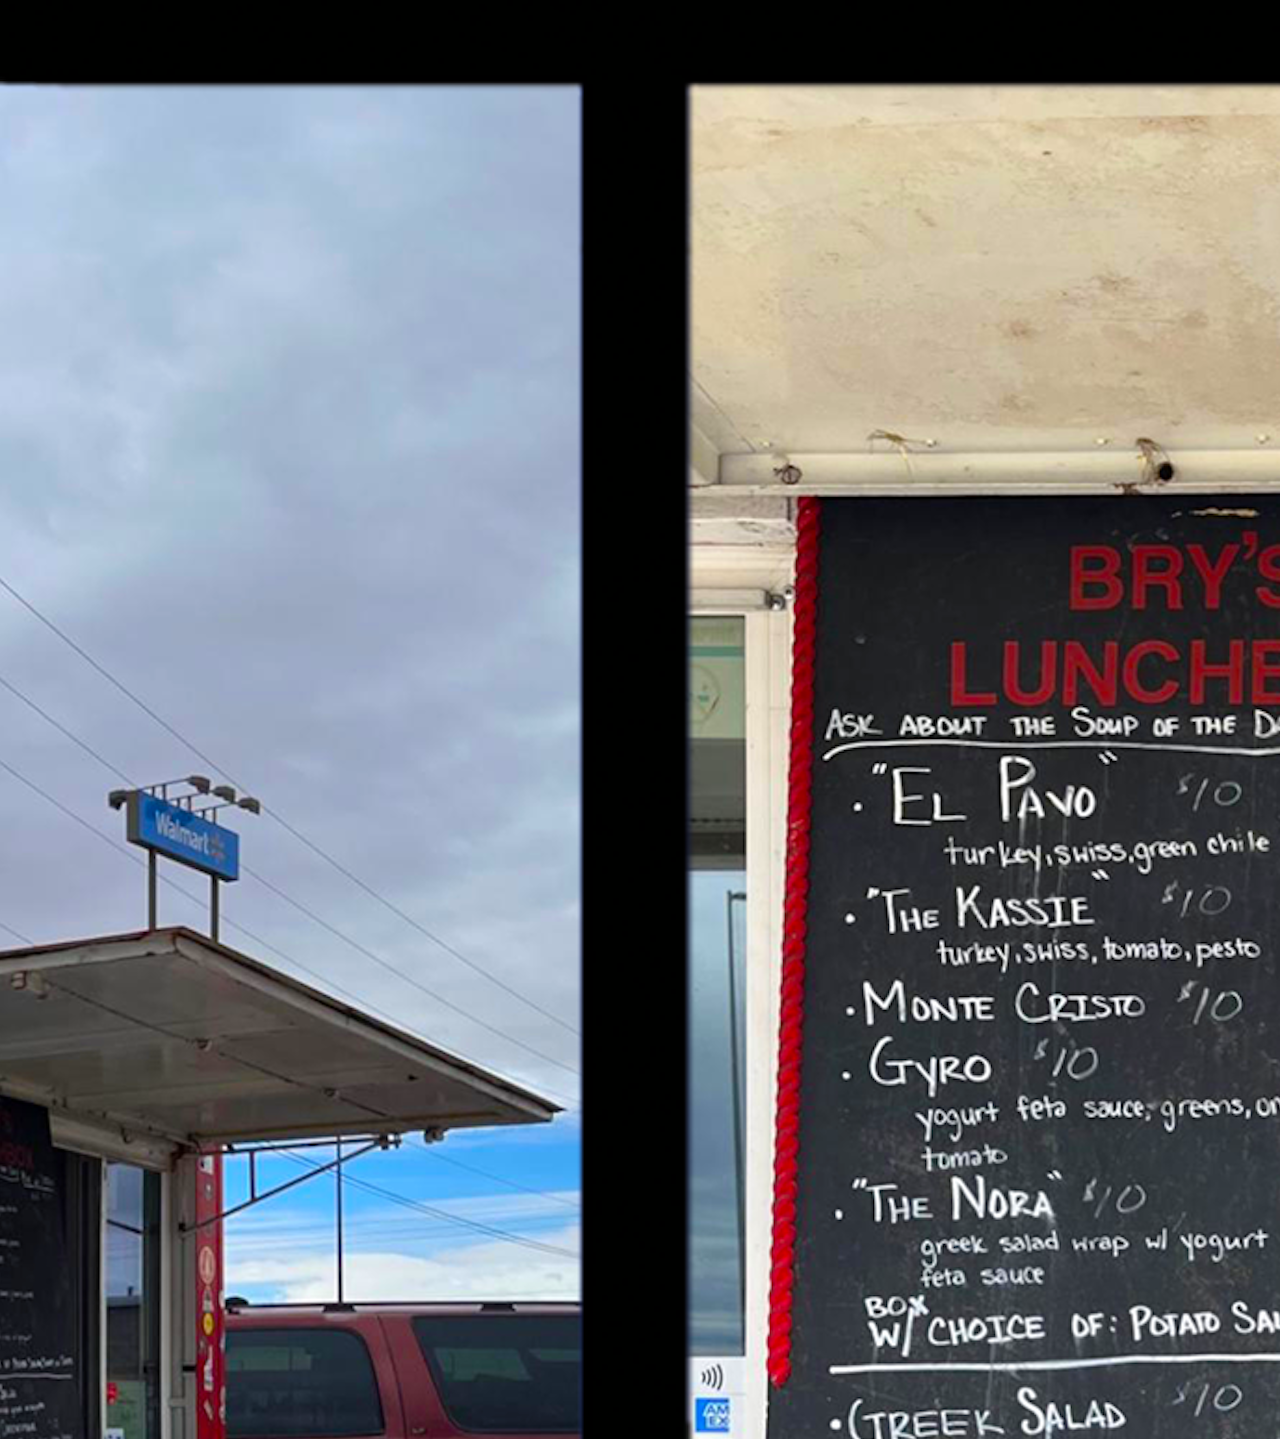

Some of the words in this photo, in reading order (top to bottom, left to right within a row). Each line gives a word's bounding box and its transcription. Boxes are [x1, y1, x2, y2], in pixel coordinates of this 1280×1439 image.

[825, 709, 883, 740] ASK
[899, 715, 987, 738] ABOUT
[1010, 716, 1057, 738] THE
[1070, 706, 1139, 738] SOUP
[1152, 716, 1180, 738] OF
[1191, 715, 1237, 737] THE
[1176, 772, 1242, 811] $10
[155, 810, 210, 856] Walmart
[1207, 831, 1270, 855] chile
[1162, 880, 1231, 917] $10
[1196, 938, 1261, 968] pesto
[863, 980, 995, 1026] MONTE
[1015, 982, 1145, 1023] CRISTO
[1177, 980, 1243, 1026] $10
[870, 1036, 991, 1097] GYRO
[1034, 1038, 1099, 1081] $10
[916, 1101, 1000, 1142] yogurt
[1018, 1095, 1066, 1123] feta
[921, 1146, 1008, 1173] tomato
[1083, 1178, 1147, 1218] $10
[921, 1231, 988, 1268] greek
[999, 1229, 1059, 1254] salad
[1073, 1235, 1130, 1262] wrap
[1180, 1229, 1270, 1263] yogurt
[921, 1267, 966, 1289] feta
[980, 1265, 1046, 1287] sauce
[865, 1293, 930, 1319] BOX
[928, 1316, 1046, 1347] CHOICE
[1071, 1313, 1118, 1340] OF:
[1130, 1305, 1220, 1342] POTATO
[1018, 1387, 1126, 1435] SALAD
